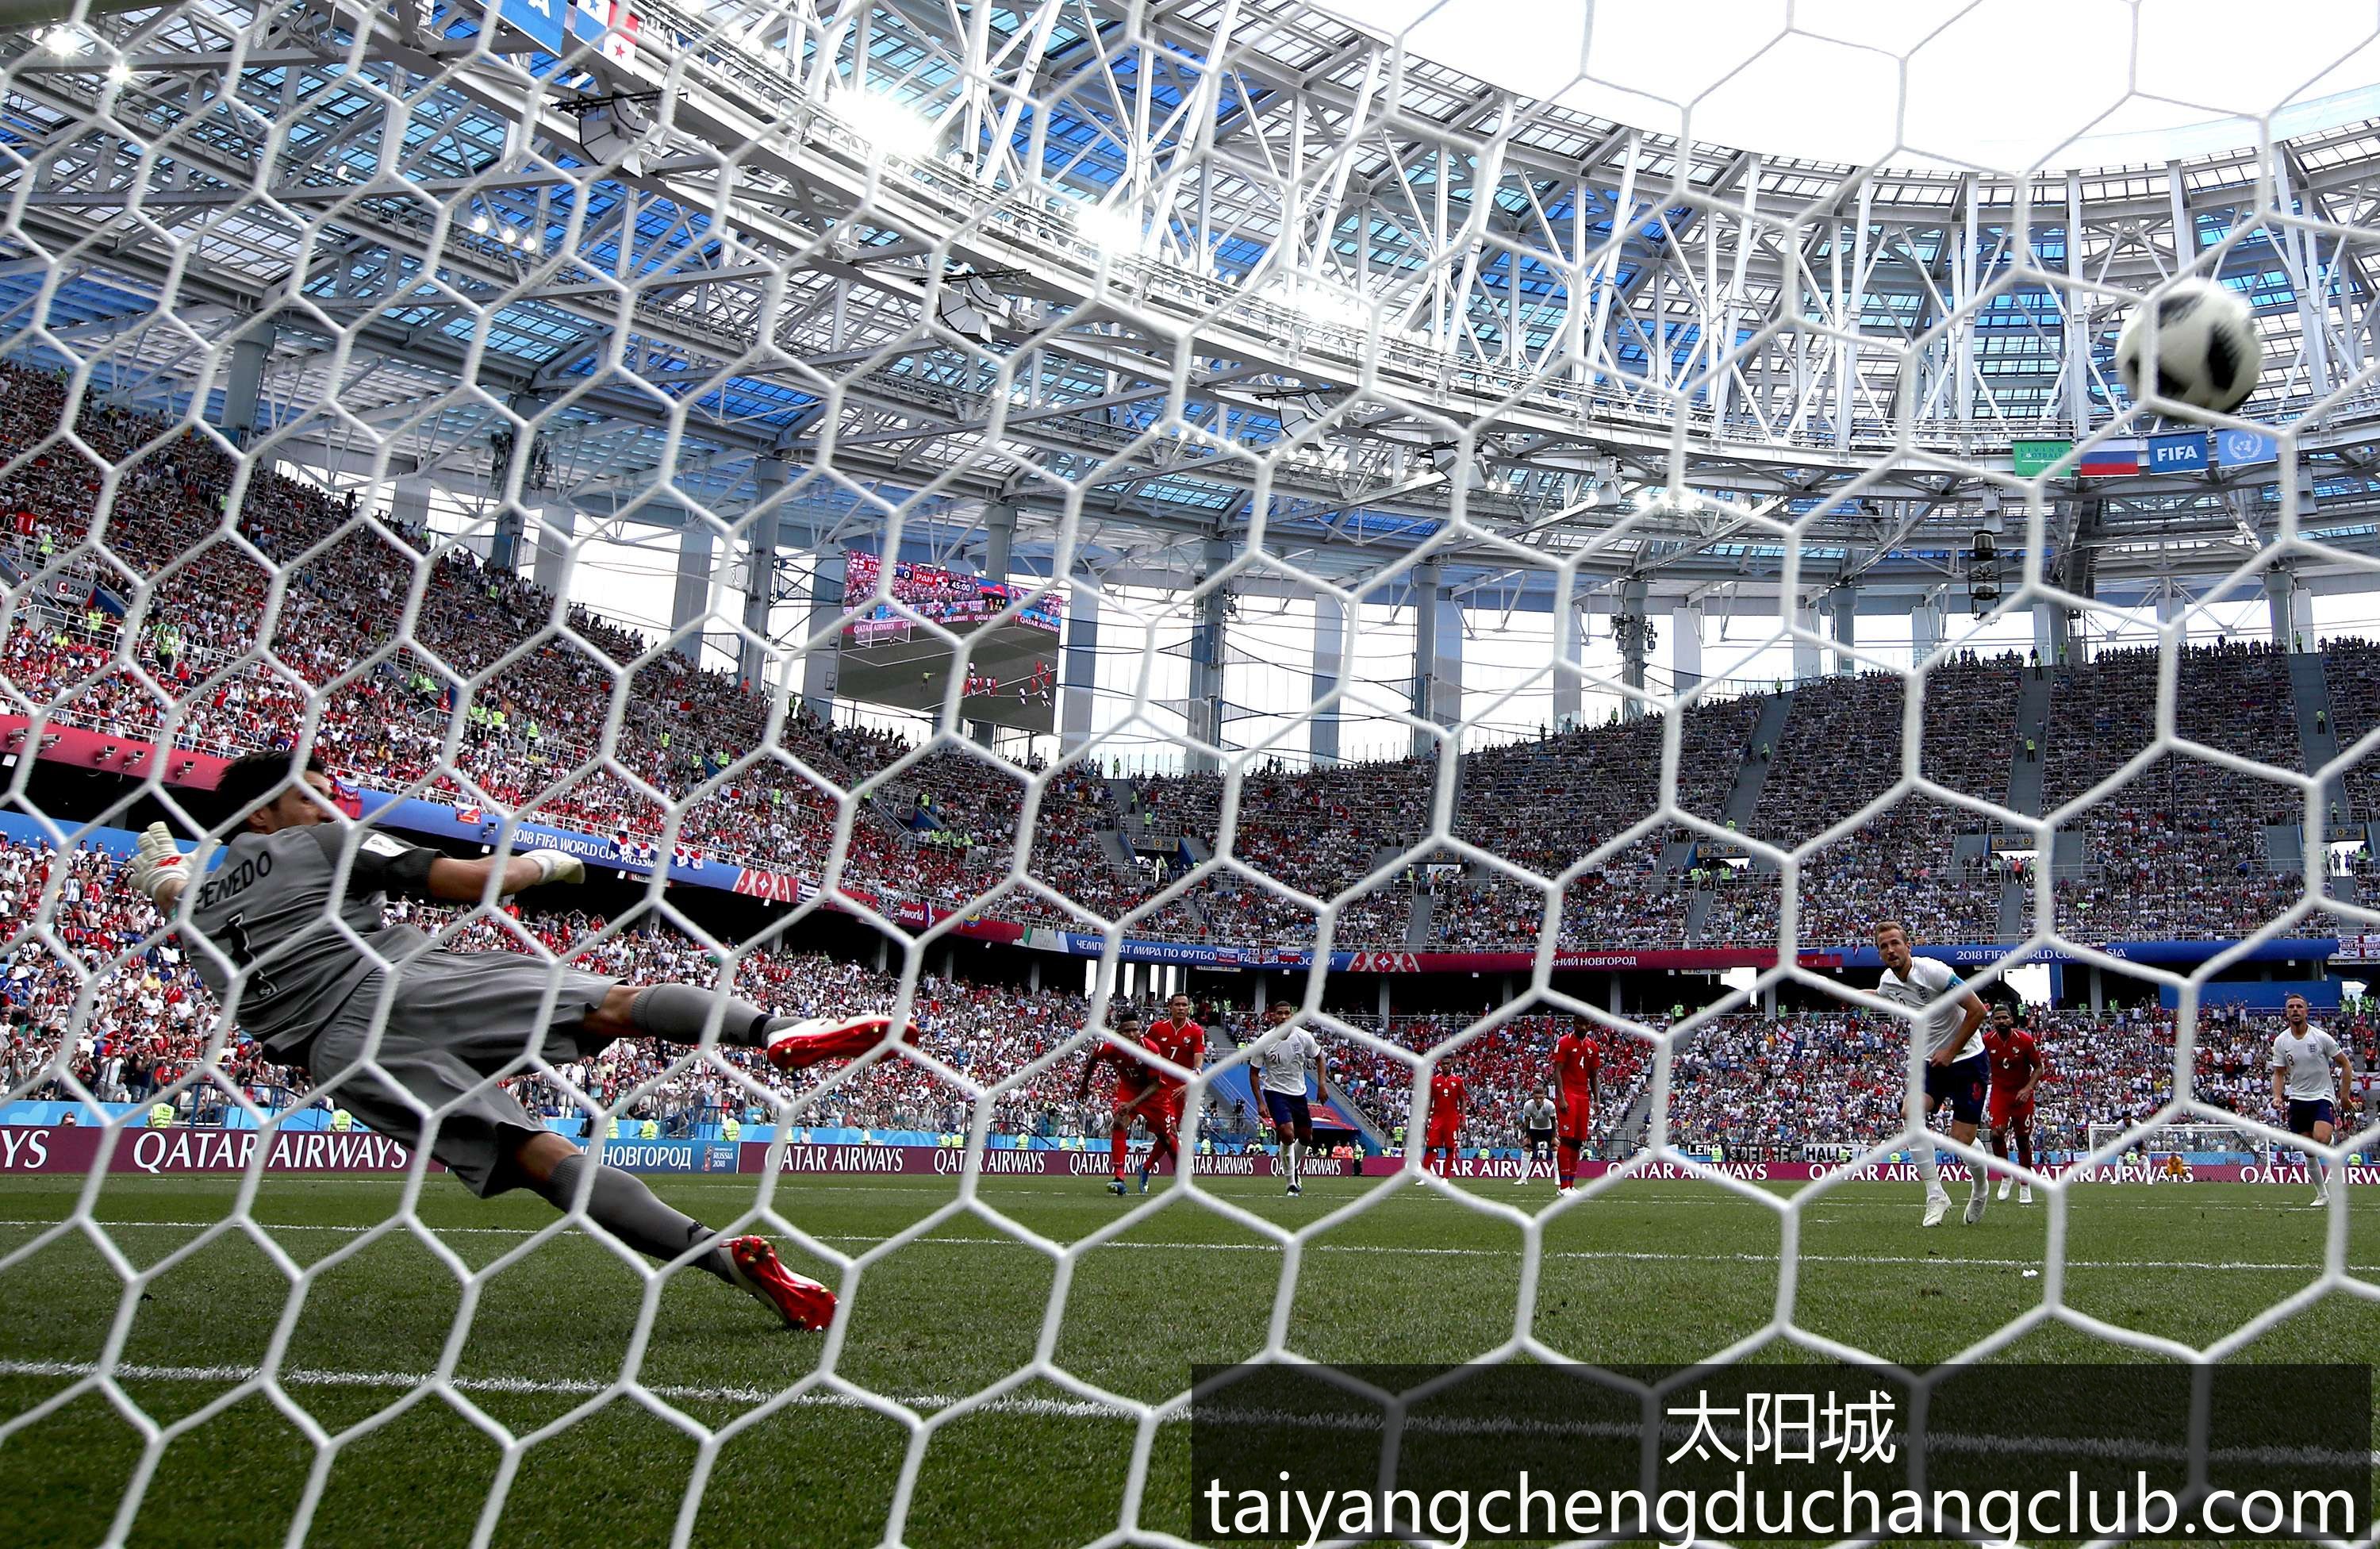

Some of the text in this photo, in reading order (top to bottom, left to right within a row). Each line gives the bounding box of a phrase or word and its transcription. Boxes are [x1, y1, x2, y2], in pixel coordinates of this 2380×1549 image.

[2157, 445, 2198, 462] FIFA
[59, 582, 67, 592] C
[70, 585, 89, 598] 220
[916, 575, 933, 583] PAN
[951, 581, 970, 592] 45:00
[1019, 617, 1038, 628] QATAR
[512, 829, 533, 844] 2018
[536, 832, 558, 850] FIFA
[559, 836, 597, 856] WORLD
[1133, 945, 1162, 957] МИРА
[1163, 947, 1180, 959] ПО
[1956, 950, 1983, 960] 2018
[1984, 950, 2009, 960] FIFA
[2013, 949, 2053, 959] ORLD
[1530, 955, 1637, 967] ННИЙ НОВГОРОД
[1169, 1046, 1178, 1059] 7
[1270, 1053, 1280, 1064] 21
[2286, 1054, 2294, 1067] 8
[1579, 1056, 1584, 1069] 4
[2002, 1058, 2010, 1069] 6
[2025, 1113, 2030, 1127] 6
[133, 1131, 408, 1174] QATAR AIRWAYS
[601, 1145, 693, 1170] НОВГОРОД
[831, 1147, 904, 1172] AIRWAYS
[934, 1149, 1045, 1174] QATR AIRWAYS
[1069, 1152, 1110, 1176] QATAR
[1190, 1155, 1253, 1175] ATAR AIRWAYS
[1270, 1158, 1341, 1177] QAR AIRWAYS
[1479, 1160, 1560, 1178] AIRWAY
[1885, 1164, 1974, 1182] AIRAYS
[2029, 1165, 2194, 1182] ATAR AIRWAS
